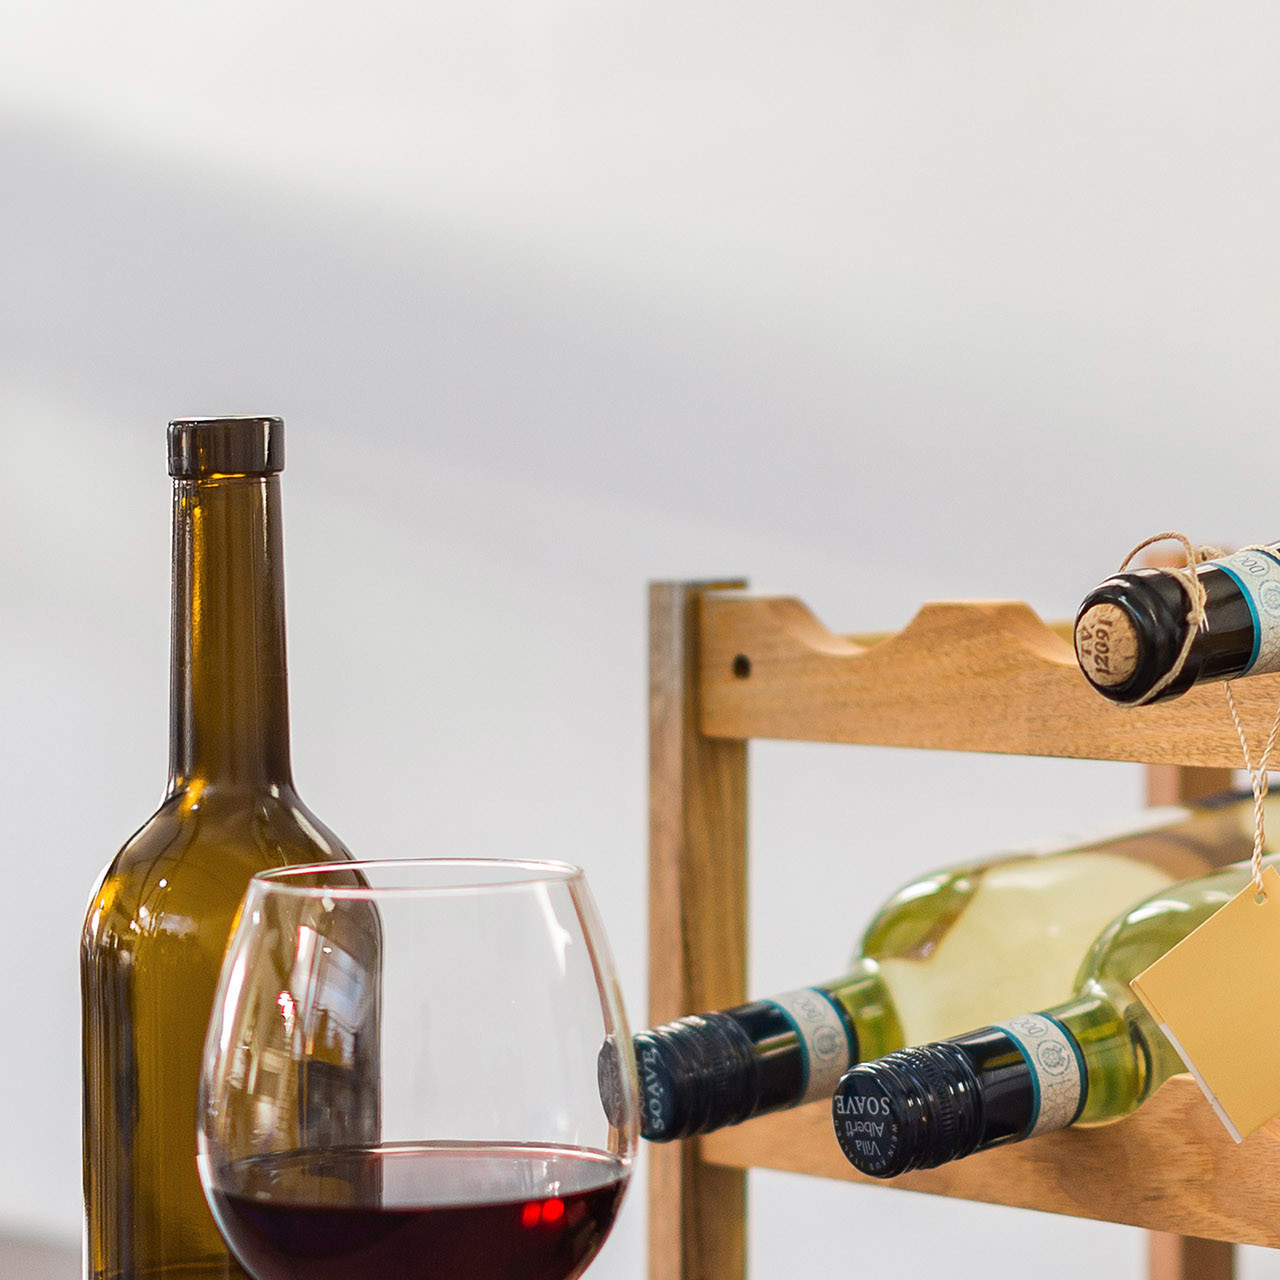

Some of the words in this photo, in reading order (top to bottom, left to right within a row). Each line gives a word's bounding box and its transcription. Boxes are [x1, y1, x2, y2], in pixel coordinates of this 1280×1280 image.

[642, 1049, 665, 1130] SOAVE
[834, 1095, 890, 1116] SOAVE
[845, 1120, 885, 1138] Alberti
[855, 1139, 881, 1156] Villa
